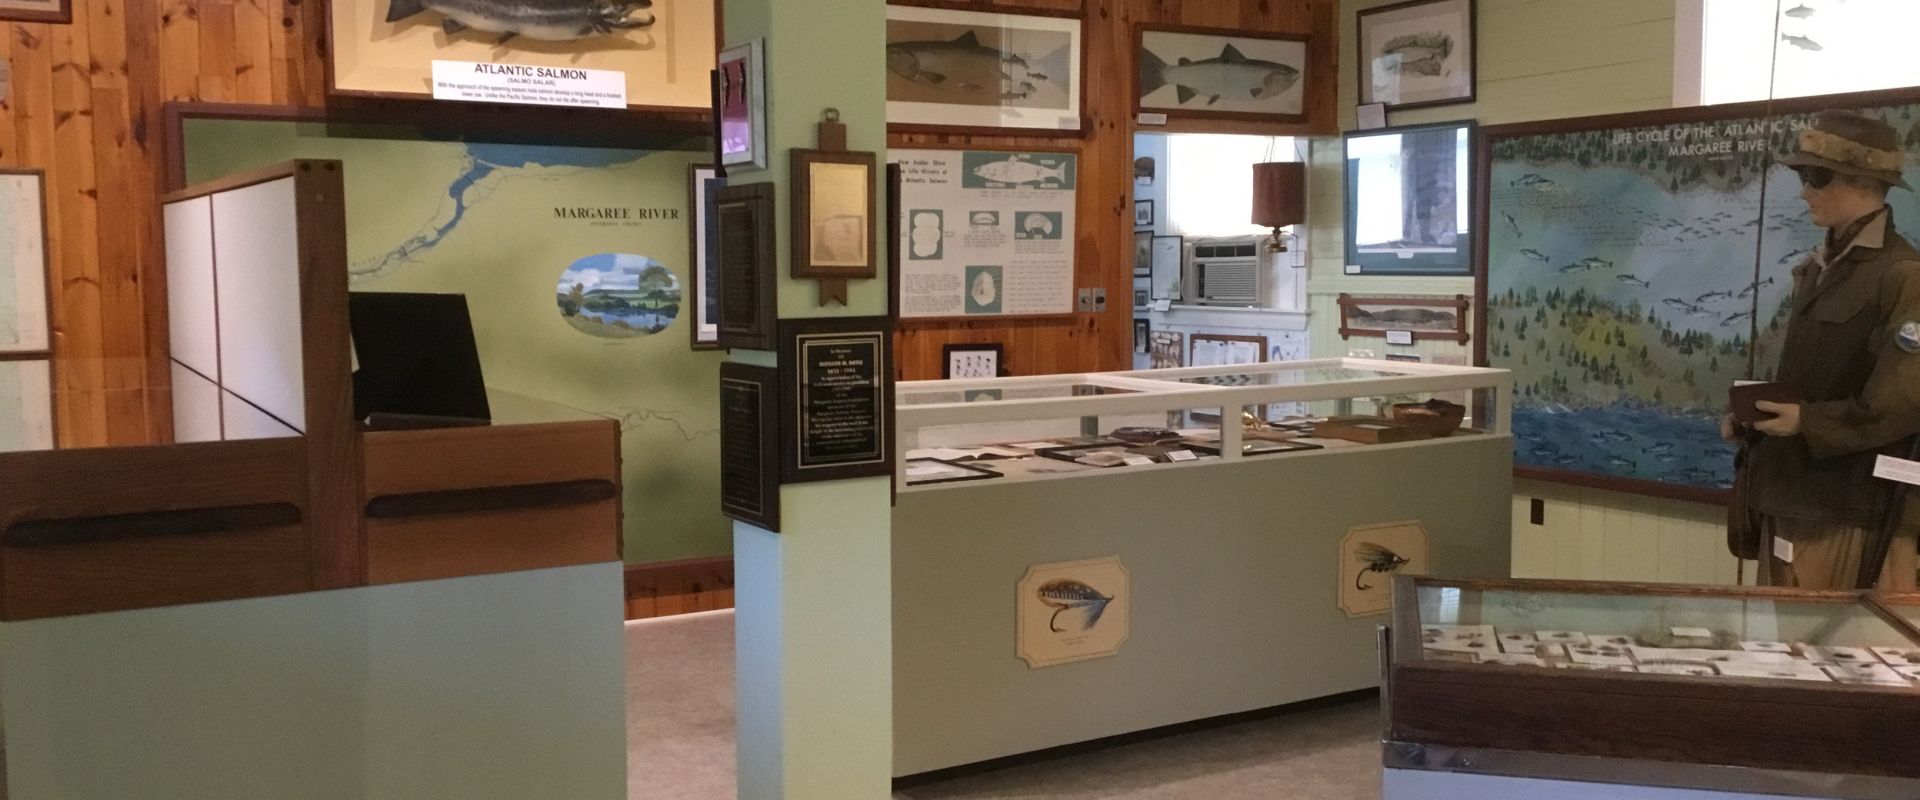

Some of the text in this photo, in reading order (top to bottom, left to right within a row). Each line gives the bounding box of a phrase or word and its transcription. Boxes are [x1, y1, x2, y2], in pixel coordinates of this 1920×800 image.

[474, 63, 587, 80] ATLANTIC SALMON
[1612, 132, 1633, 145] LIFE
[1636, 129, 1670, 143] CYCLE
[1673, 127, 1689, 140] OF
[1693, 126, 1715, 138] THE
[1668, 140, 1732, 157] MARGAREE
[554, 207, 679, 219] MARGAREE RIVER
